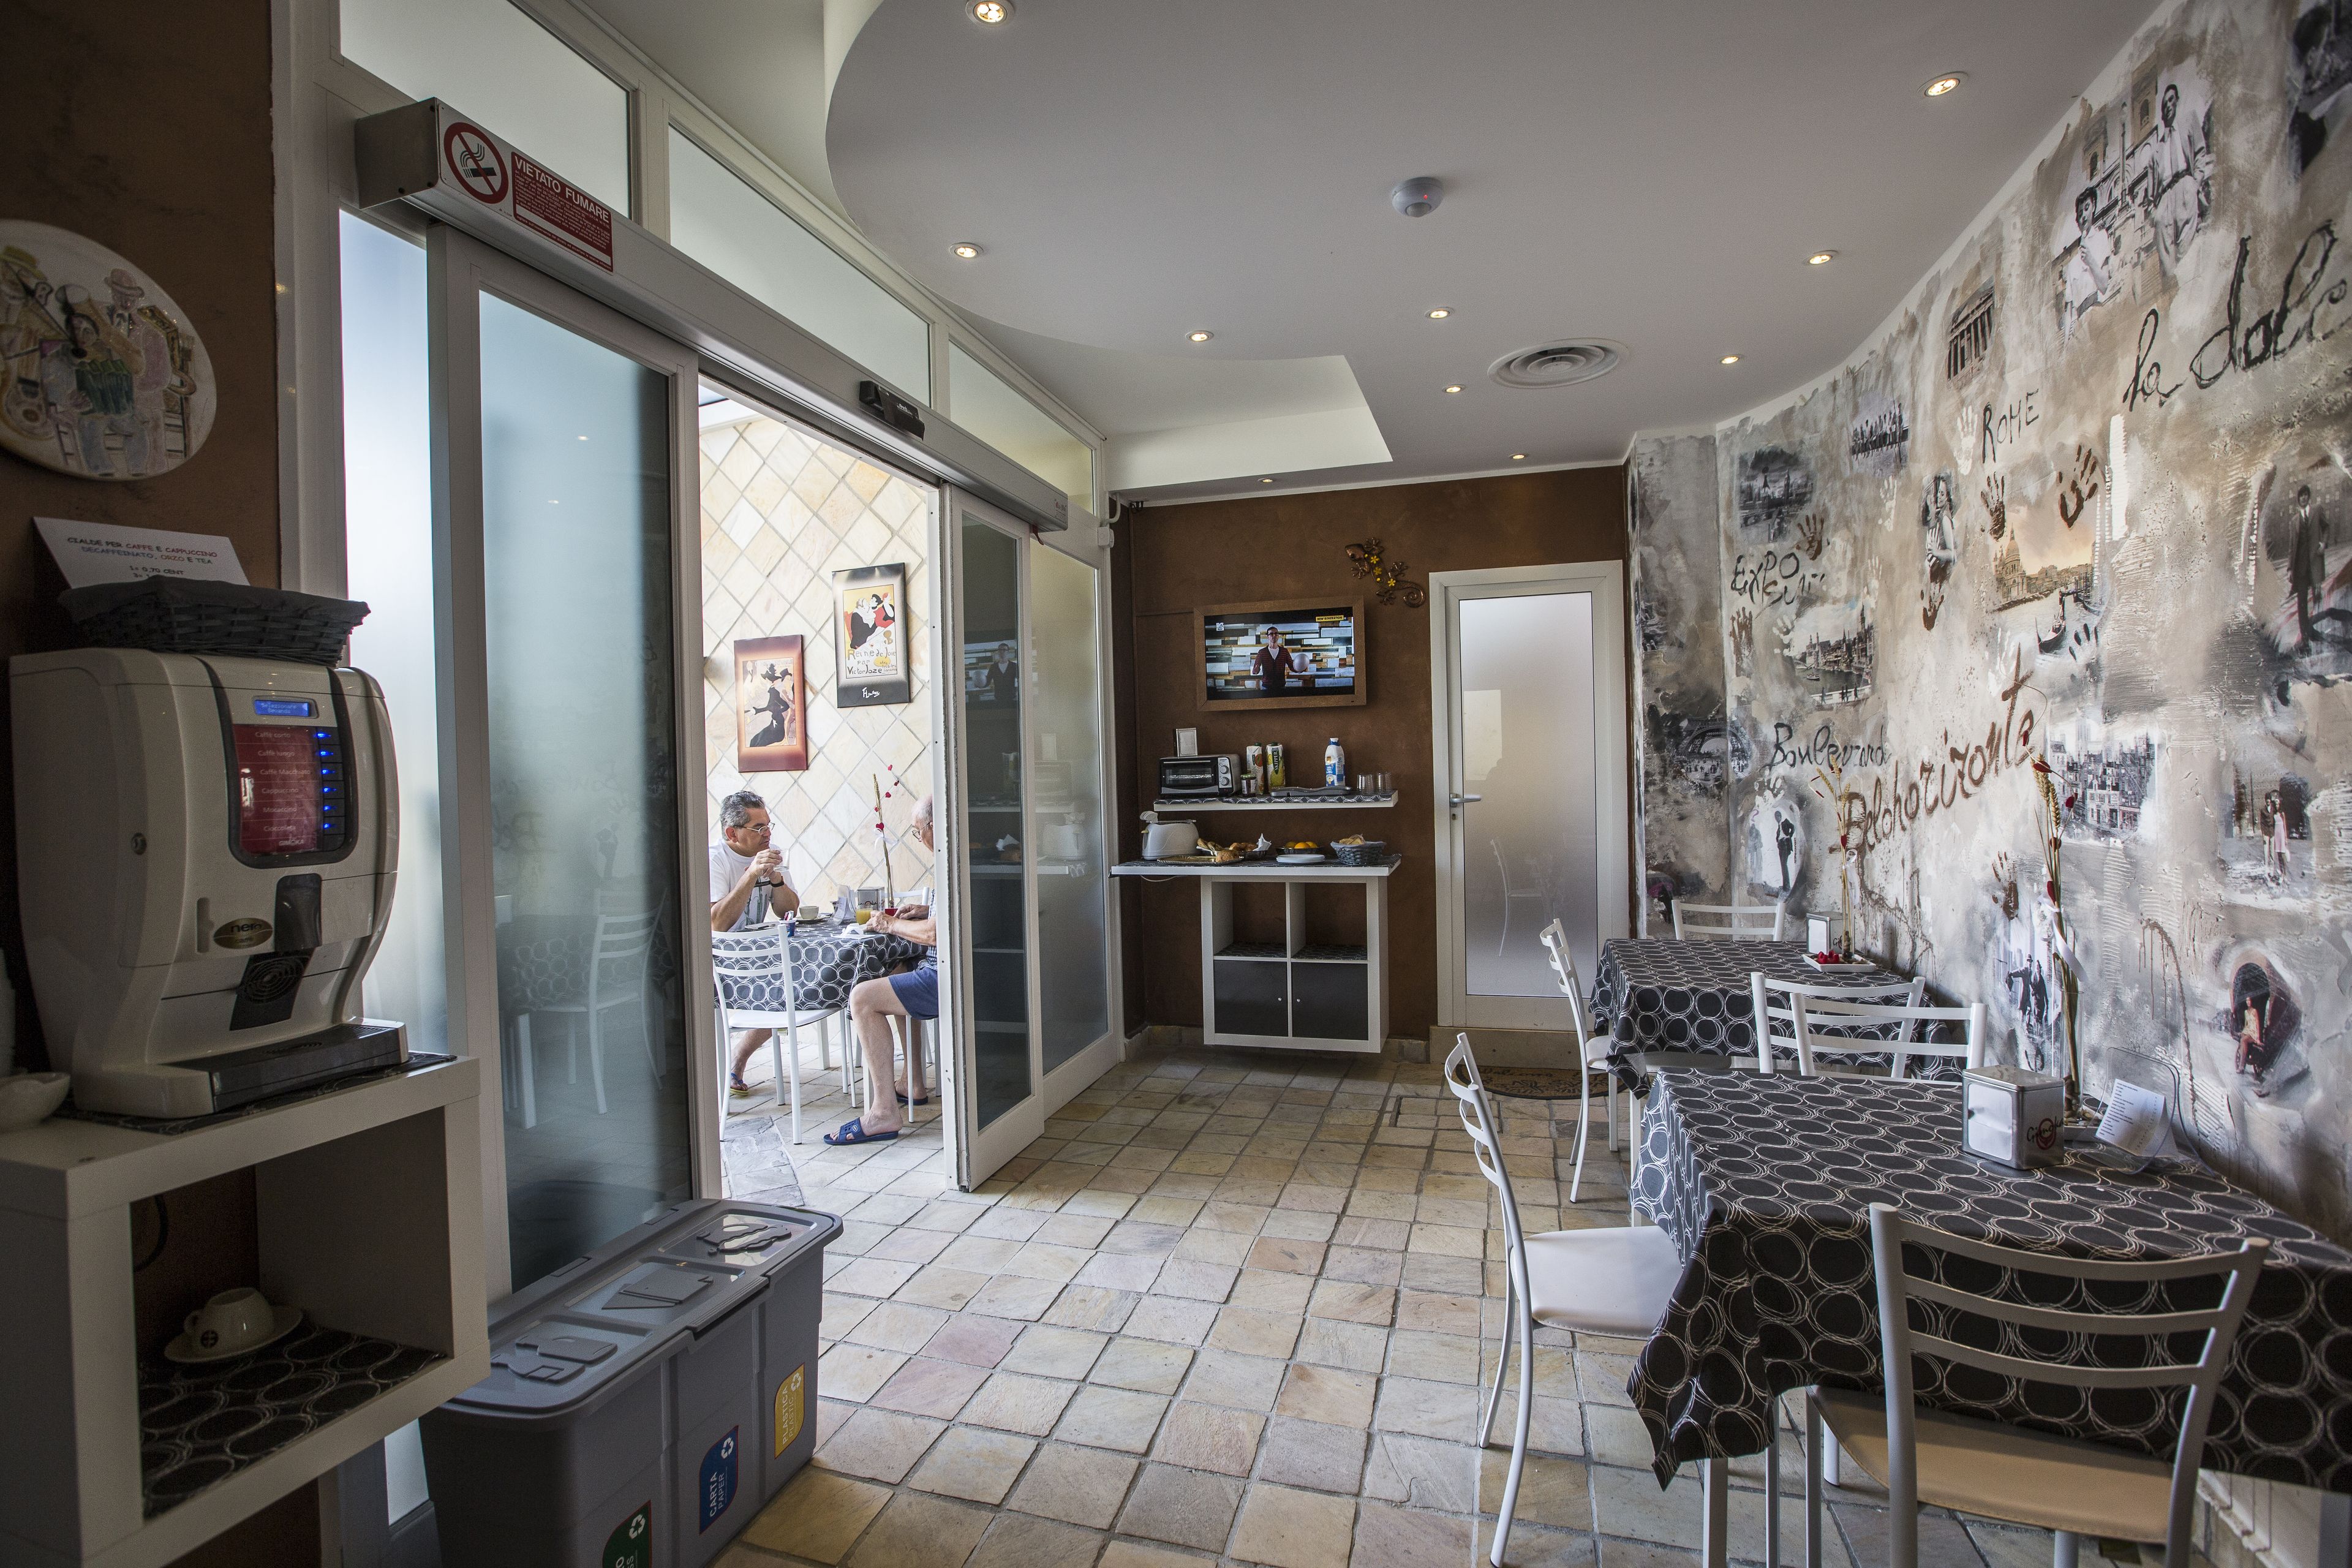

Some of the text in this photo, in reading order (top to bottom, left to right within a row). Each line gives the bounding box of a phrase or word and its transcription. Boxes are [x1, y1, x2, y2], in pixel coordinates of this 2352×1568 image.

[514, 156, 609, 223] VIETATO FUMARE
[2122, 309, 2188, 412] la
[67, 537, 104, 547] CIALDE
[126, 543, 153, 551] CAFFE
[165, 547, 217, 557] CAPPUCCINO
[1731, 551, 1800, 605] EXPO
[848, 649, 874, 660] Reine
[1761, 722, 1891, 771] Boulevard
[231, 924, 262, 932] nero
